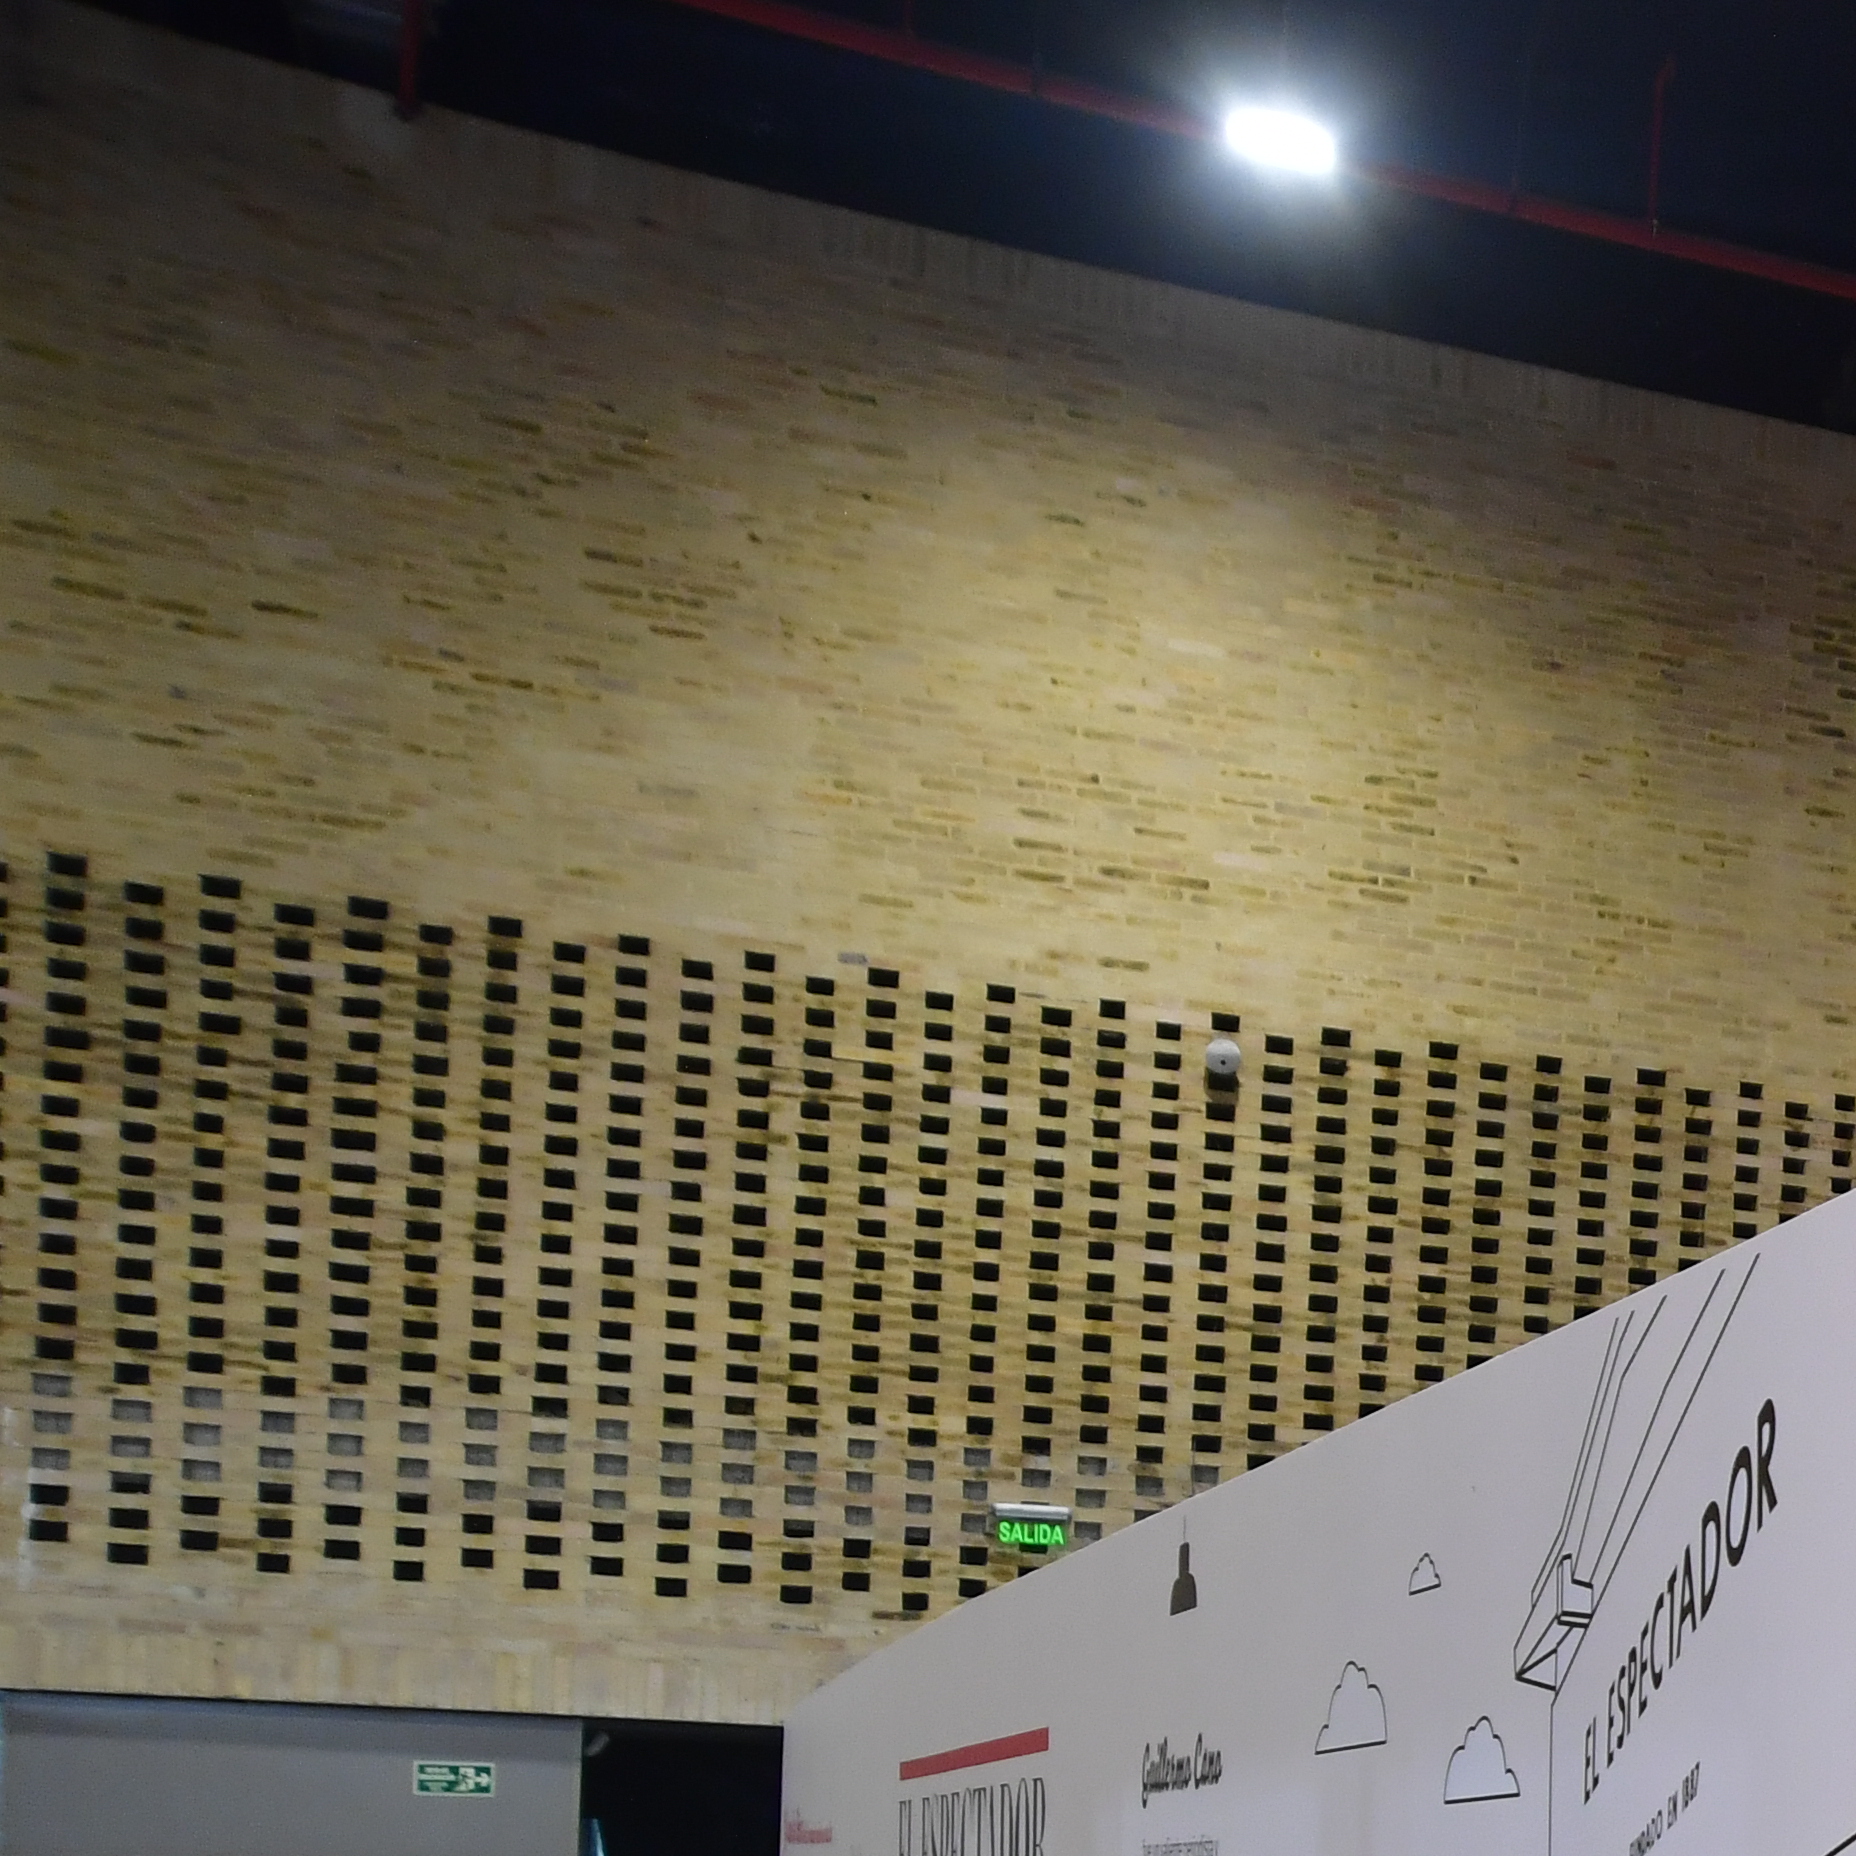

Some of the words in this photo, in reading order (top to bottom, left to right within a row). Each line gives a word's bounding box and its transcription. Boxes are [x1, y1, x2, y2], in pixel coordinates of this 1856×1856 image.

[999, 1521, 1064, 1545] SALIDA
[1583, 1716, 1599, 1805] EL
[1606, 1398, 1777, 1768] ESPECTADOR
[1142, 1736, 1191, 1808] Guillermo
[1194, 1733, 1222, 1789] Cano
[1667, 1790, 1678, 1830] EN
